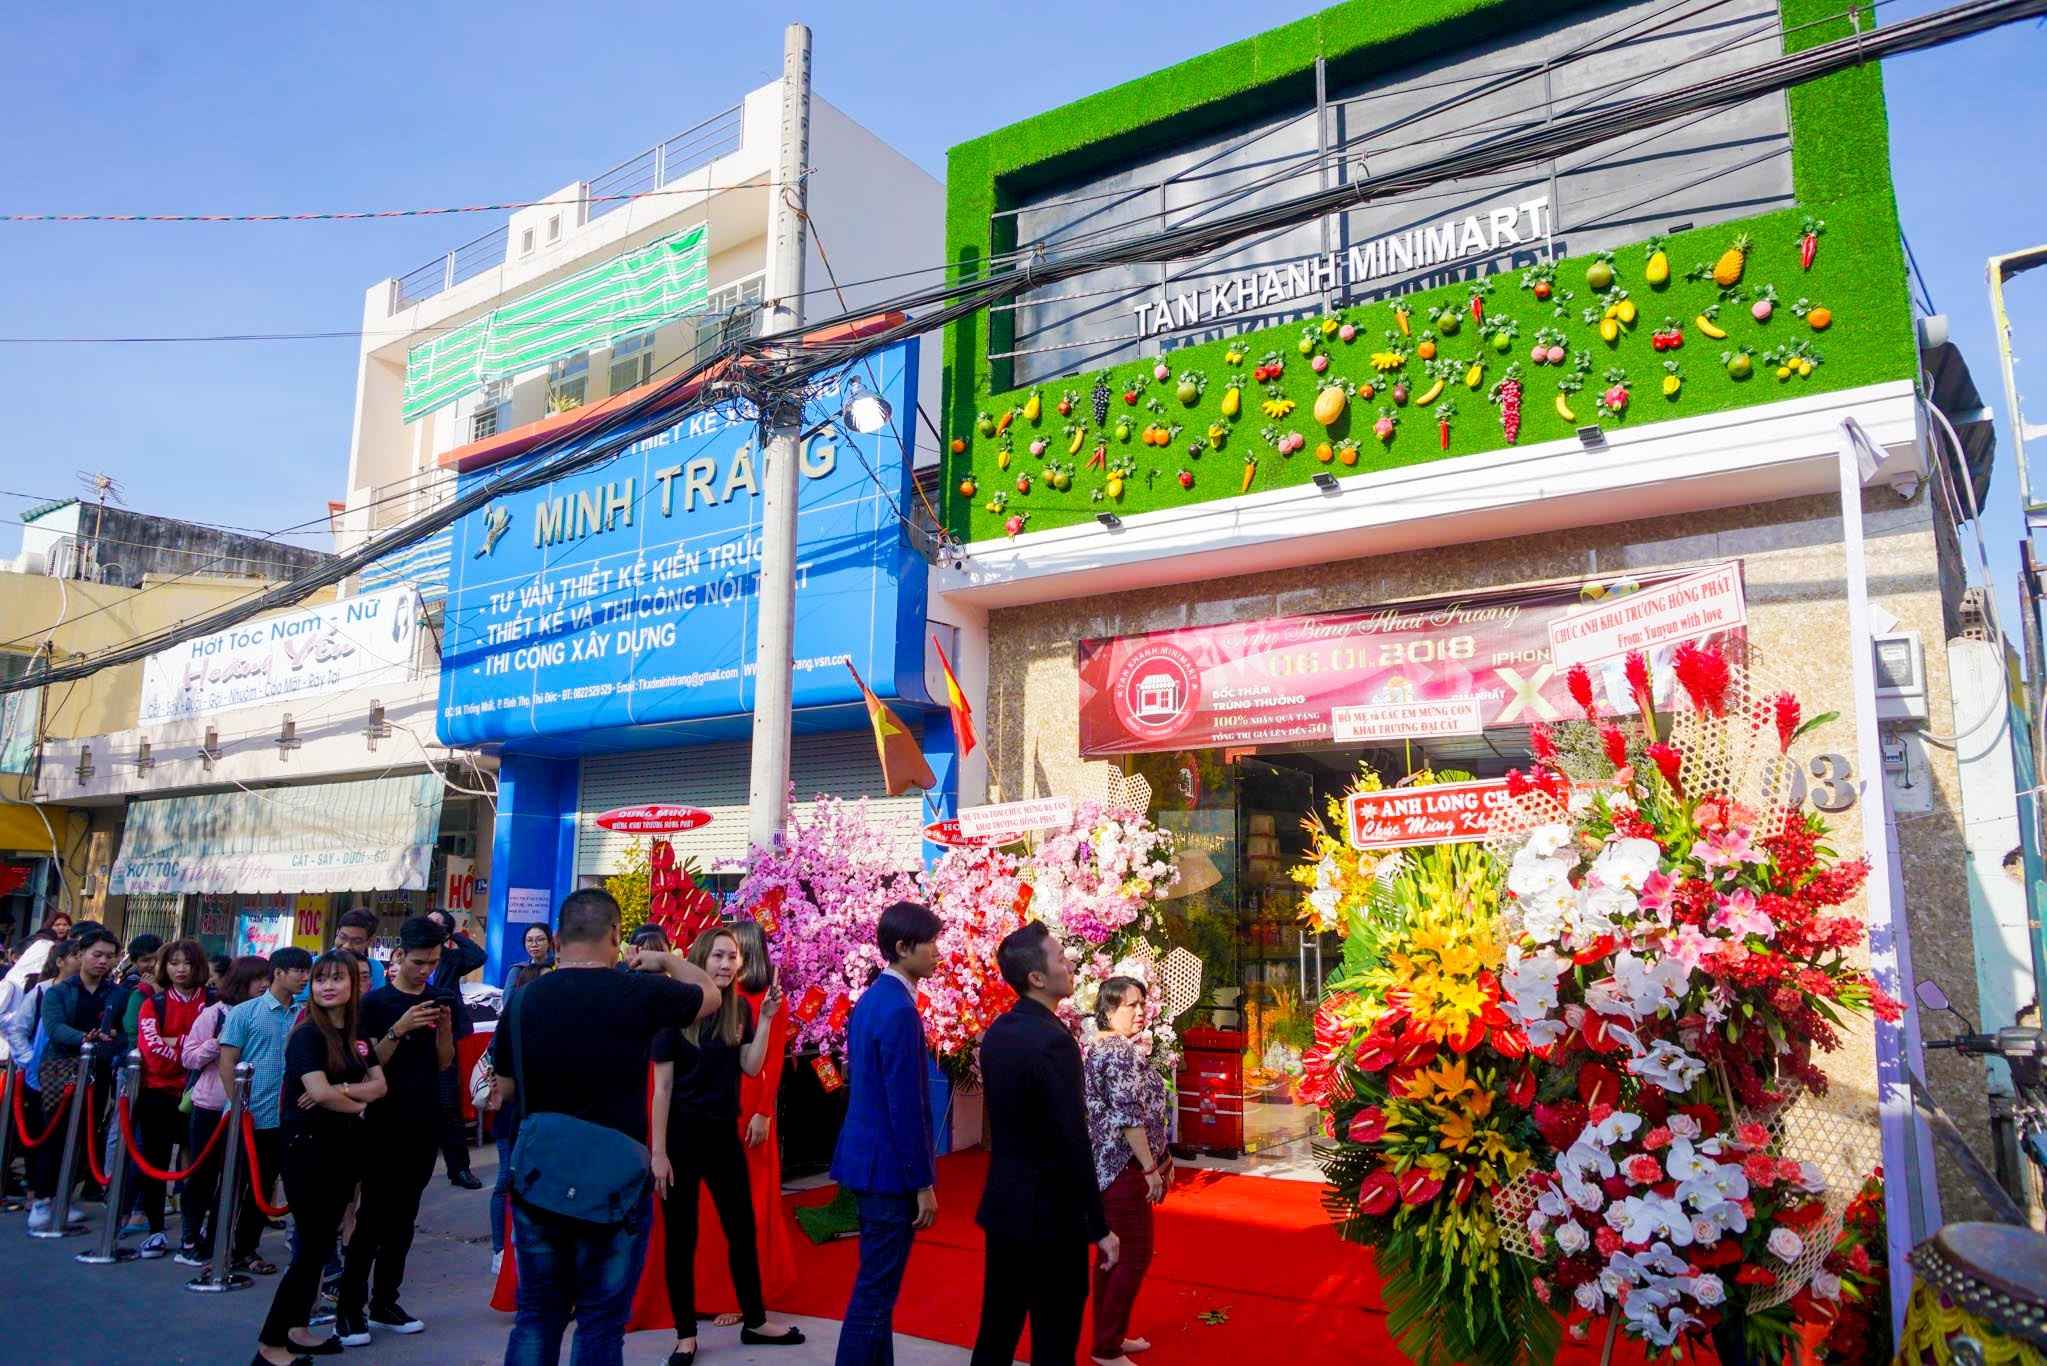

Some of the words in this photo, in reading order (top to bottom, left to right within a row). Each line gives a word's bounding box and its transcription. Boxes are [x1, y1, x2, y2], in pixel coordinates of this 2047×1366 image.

[1134, 290, 1200, 337] TAN
[1211, 252, 1338, 318] KHANH
[1349, 197, 1550, 282] MINIMART
[534, 478, 636, 548] MINH
[490, 591, 514, 616] TƯ
[520, 574, 554, 609] VẤN
[560, 561, 612, 603] THIẾT
[618, 551, 645, 588] KẾ
[652, 545, 700, 582] KIẾN
[487, 609, 534, 647] THIẾT
[540, 604, 564, 636] KẾ
[571, 600, 594, 630] VÀ
[602, 598, 632, 625] THI
[637, 586, 697, 618] CÔNG
[705, 571, 743, 608] NỘI
[1358, 607, 1425, 635] Khai
[1554, 623, 1579, 645] CHÚC
[1580, 620, 1599, 636] ANH
[1600, 613, 1624, 631] KHAI
[1625, 597, 1667, 623] TRƯƠNG
[1668, 584, 1700, 611] HỒNG
[1701, 574, 1731, 600] PHÁT
[192, 635, 223, 659] Hớt
[230, 629, 263, 649] Tóc
[271, 615, 321, 641] Nam
[347, 598, 381, 624] Nữ
[1617, 631, 1644, 649] From:
[1644, 621, 1679, 641] Yunyun
[1680, 612, 1701, 631] with
[1702, 606, 1723, 623] love
[485, 654, 510, 676] THI
[514, 642, 565, 672] CÔNG
[570, 631, 611, 662] XÂY
[616, 623, 677, 658] DỰNG
[1127, 647, 1158, 670] KHANH
[1160, 647, 1198, 681] MINIMART
[1268, 635, 1477, 677] 06.01.2018
[1491, 648, 1552, 666] IPHON
[1212, 686, 1236, 699] BỐC
[1212, 698, 1252, 711] TRÚNG
[1254, 693, 1306, 708] THƯỞNG
[1494, 663, 1560, 722] X
[1213, 714, 1249, 728] 100%
[1353, 724, 1376, 736] KHAI
[1378, 722, 1418, 735] TRƯƠNG
[1402, 709, 1417, 719] EM
[1451, 704, 1472, 716] CON
[1381, 798, 1424, 818] ANH
[1425, 794, 1479, 815] LONG
[1361, 820, 1401, 841] Chúc
[297, 901, 322, 936] TÓC
